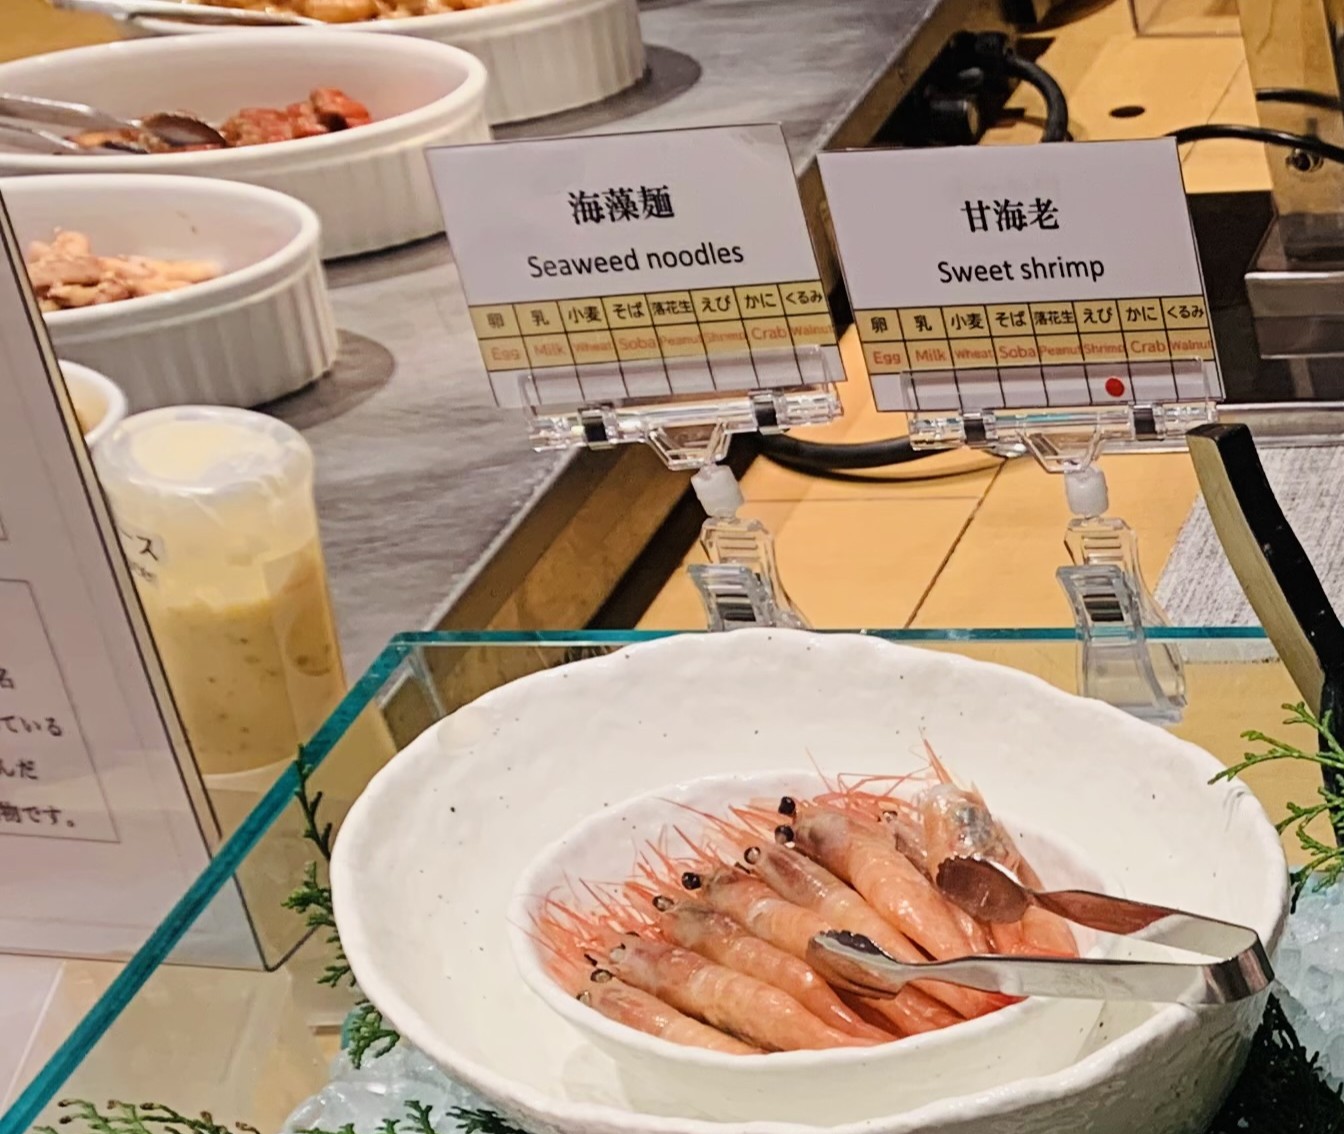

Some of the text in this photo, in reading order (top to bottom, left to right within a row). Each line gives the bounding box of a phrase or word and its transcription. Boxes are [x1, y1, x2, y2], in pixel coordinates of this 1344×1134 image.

[569, 185, 674, 225] 海藻麺
[961, 198, 1059, 232] 甘海老
[528, 242, 743, 277] Seaweed noodles
[938, 257, 1104, 283] Sweet shrimp
[565, 304, 602, 323] 小麦
[611, 302, 646, 319] そば
[650, 299, 694, 316] 落花生
[698, 295, 734, 313] えび
[742, 292, 777, 310] かに
[785, 290, 824, 306] くるみ
[870, 305, 1204, 333] 卵 乳 小麦 そば 落花生 えび かに くるみ
[490, 345, 522, 363] Egg
[533, 342, 566, 357] Milk
[618, 335, 658, 351] Soba
[751, 325, 788, 341] Crab
[874, 350, 905, 367] Egg
[916, 348, 949, 363] Milk
[1001, 344, 1040, 359] Soba
[1041, 344, 1085, 358] Peanut
[1132, 339, 1167, 354] Crab
